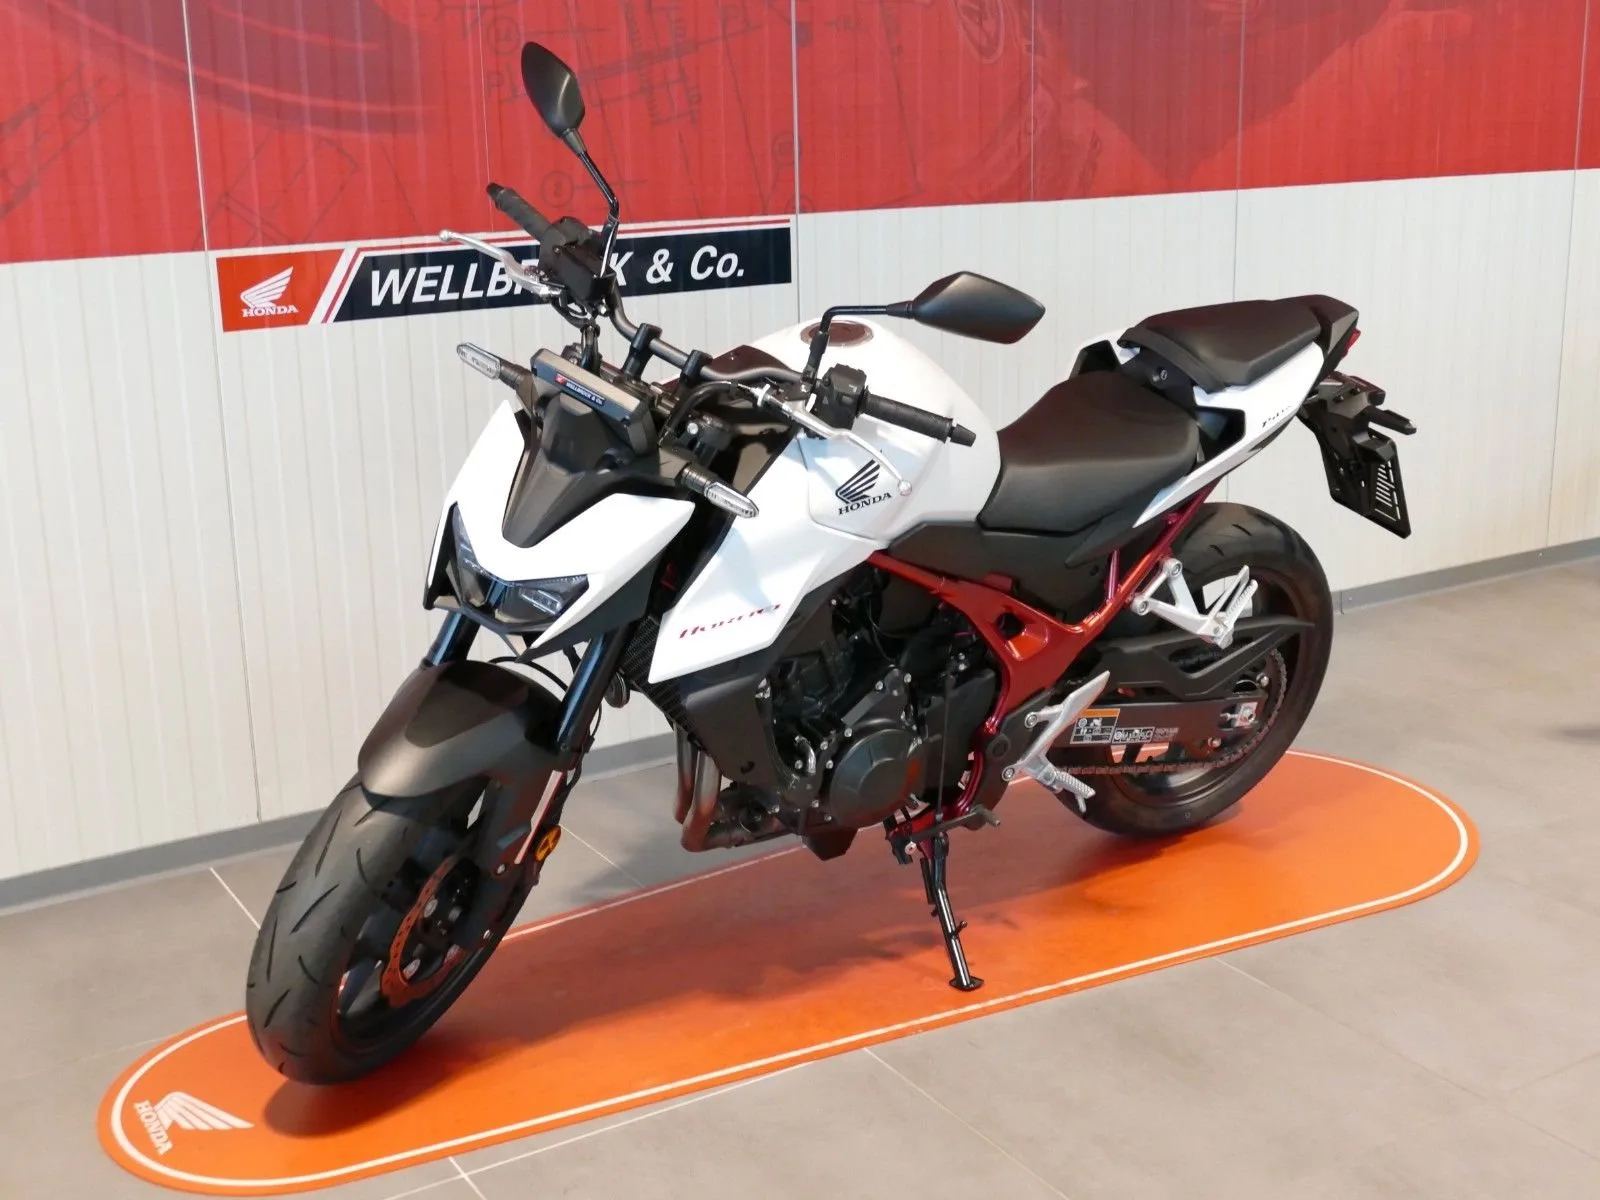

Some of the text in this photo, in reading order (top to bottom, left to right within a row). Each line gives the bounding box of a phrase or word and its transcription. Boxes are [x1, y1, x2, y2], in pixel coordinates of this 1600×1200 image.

[645, 248, 674, 284] &
[690, 245, 745, 281] Co.
[241, 304, 299, 317] HONDA
[838, 492, 892, 516] HONDA
[133, 1099, 174, 1156] HONDA
